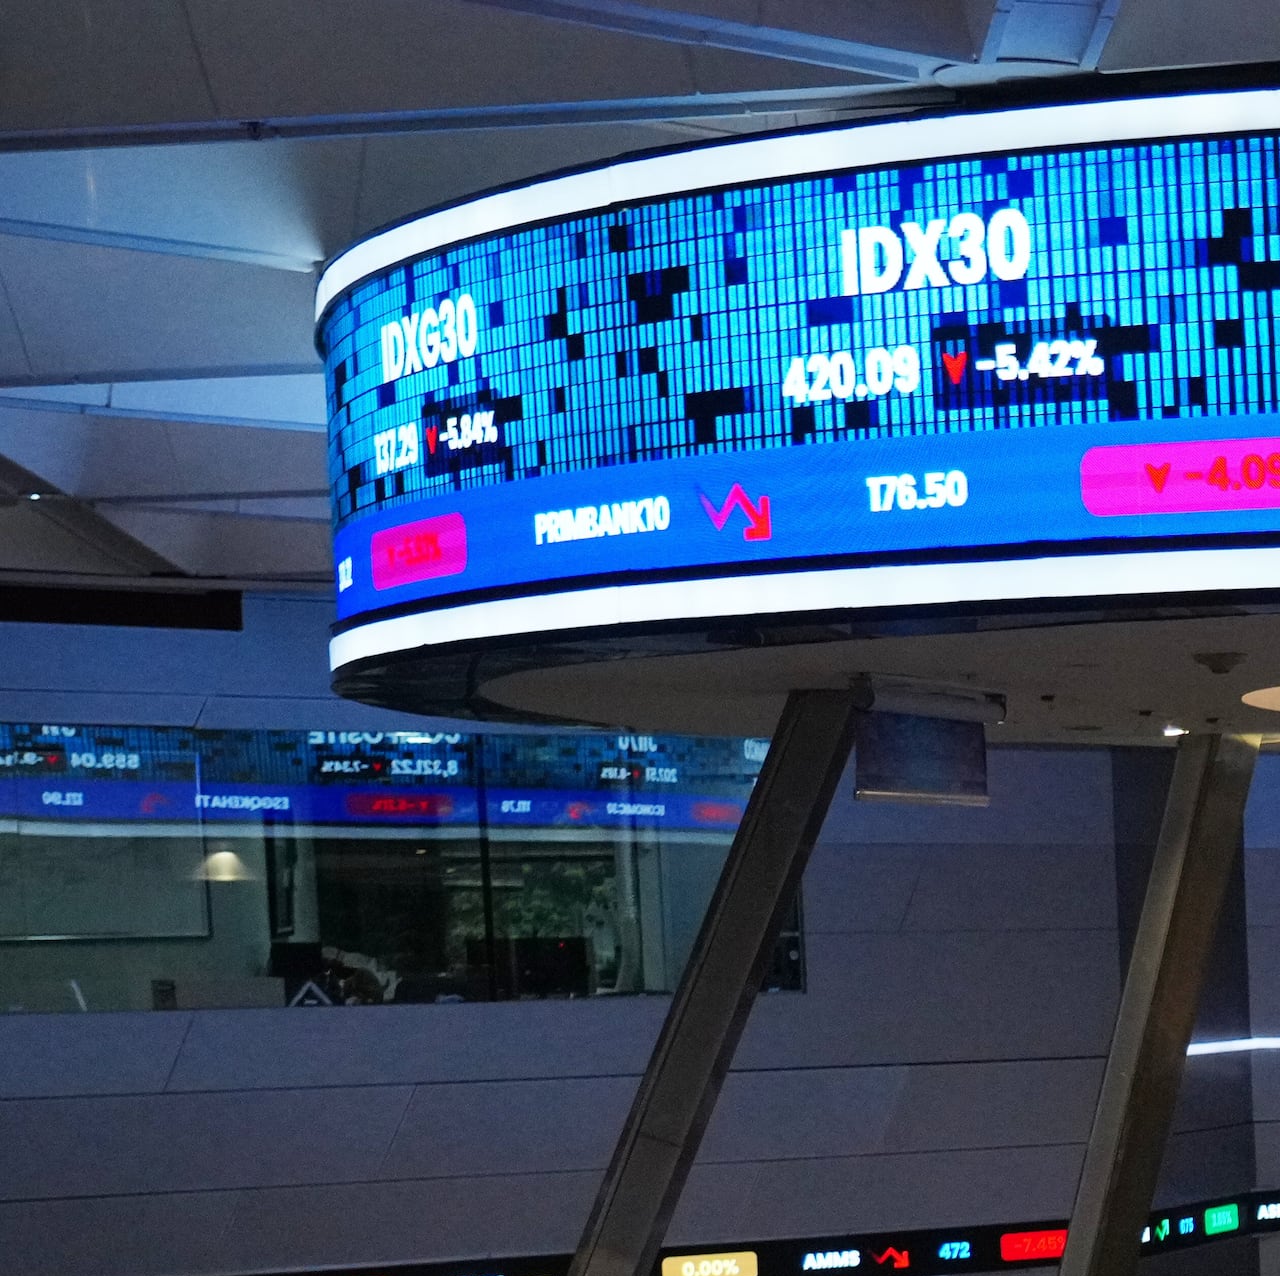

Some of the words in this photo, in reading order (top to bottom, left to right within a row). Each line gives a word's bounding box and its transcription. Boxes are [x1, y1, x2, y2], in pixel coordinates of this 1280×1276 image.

[840, 207, 1031, 297] IDX30
[380, 294, 478, 382] IDXG30
[782, 346, 921, 404] 420.09
[975, 339, 1105, 381] -5.42%
[374, 422, 418, 475] 137.29
[439, 411, 498, 450] -5.84%
[534, 495, 670, 545] PRIMBANK10
[866, 470, 968, 512] 176.50
[803, 1250, 861, 1270] AMMS
[938, 1241, 971, 1260] 472
